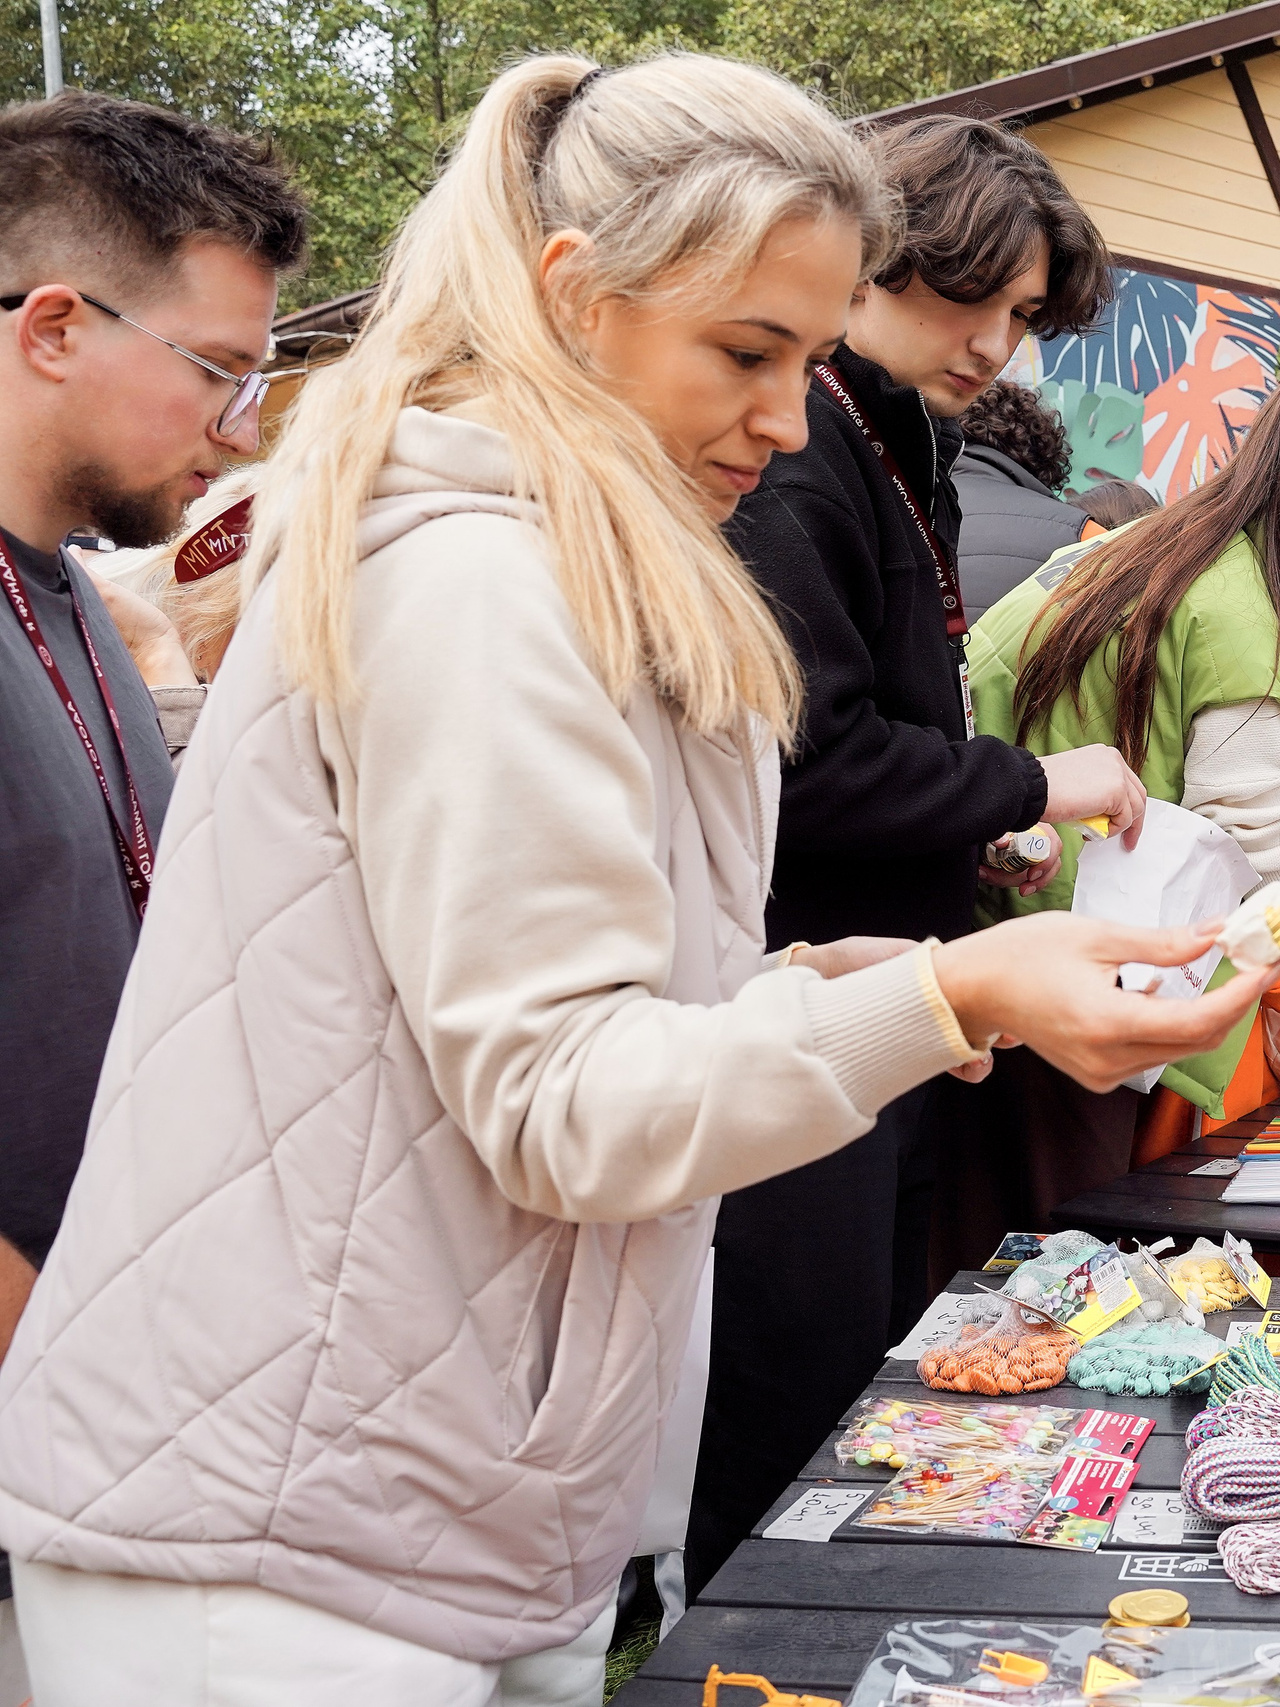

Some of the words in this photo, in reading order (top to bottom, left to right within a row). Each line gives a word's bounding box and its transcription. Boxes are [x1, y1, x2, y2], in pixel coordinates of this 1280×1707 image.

[814, 364, 864, 427] ФУНДАМЕНТ
[0, 549, 28, 617] ФУНДА
[1025, 835, 1045, 853] 10
